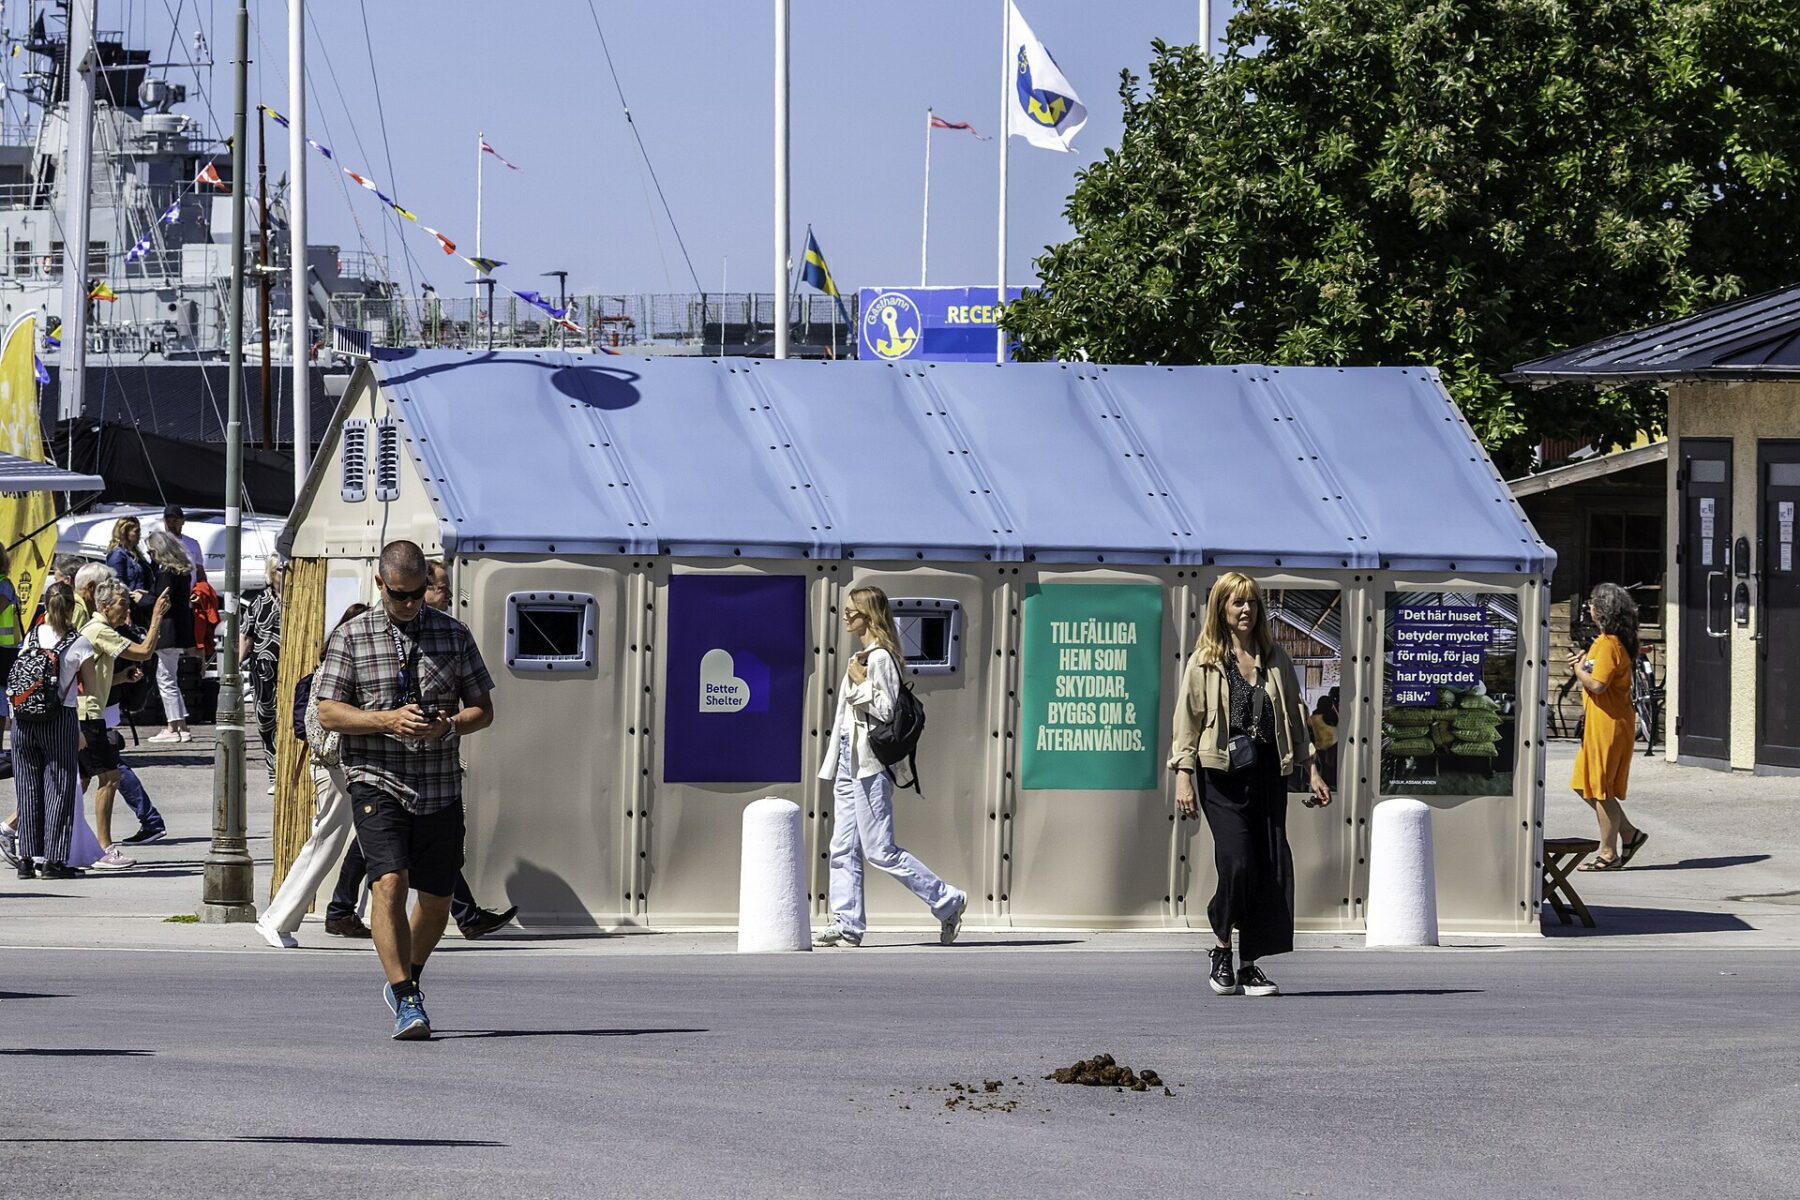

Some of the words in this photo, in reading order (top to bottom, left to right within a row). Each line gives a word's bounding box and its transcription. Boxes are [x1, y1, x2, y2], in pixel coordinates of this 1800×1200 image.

[1427, 610, 1446, 620] här
[1448, 610, 1481, 621] huset
[1050, 617, 1137, 644] TILLFÄLLIGA
[1397, 630, 1444, 643] betyder
[1446, 631, 1489, 644] mycket
[1060, 648, 1092, 671] HEM
[1094, 649, 1127, 671] SOM
[1397, 650, 1415, 661] för
[1416, 650, 1442, 664] mig,
[1443, 650, 1461, 662] för
[1461, 651, 1480, 665] jag
[1396, 670, 1417, 682] har
[1418, 670, 1453, 684] byggt
[1454, 671, 1474, 682] det
[706, 683, 739, 694] Better
[1055, 675, 1130, 700] SKYDDAR,
[706, 695, 743, 706] Shelter
[1396, 691, 1431, 704] själv.”
[1047, 702, 1097, 725] BYGGS
[1099, 702, 1122, 725] OM
[1125, 702, 1137, 725] &
[1036, 725, 1146, 752] ÅTERANVÄNDS.
